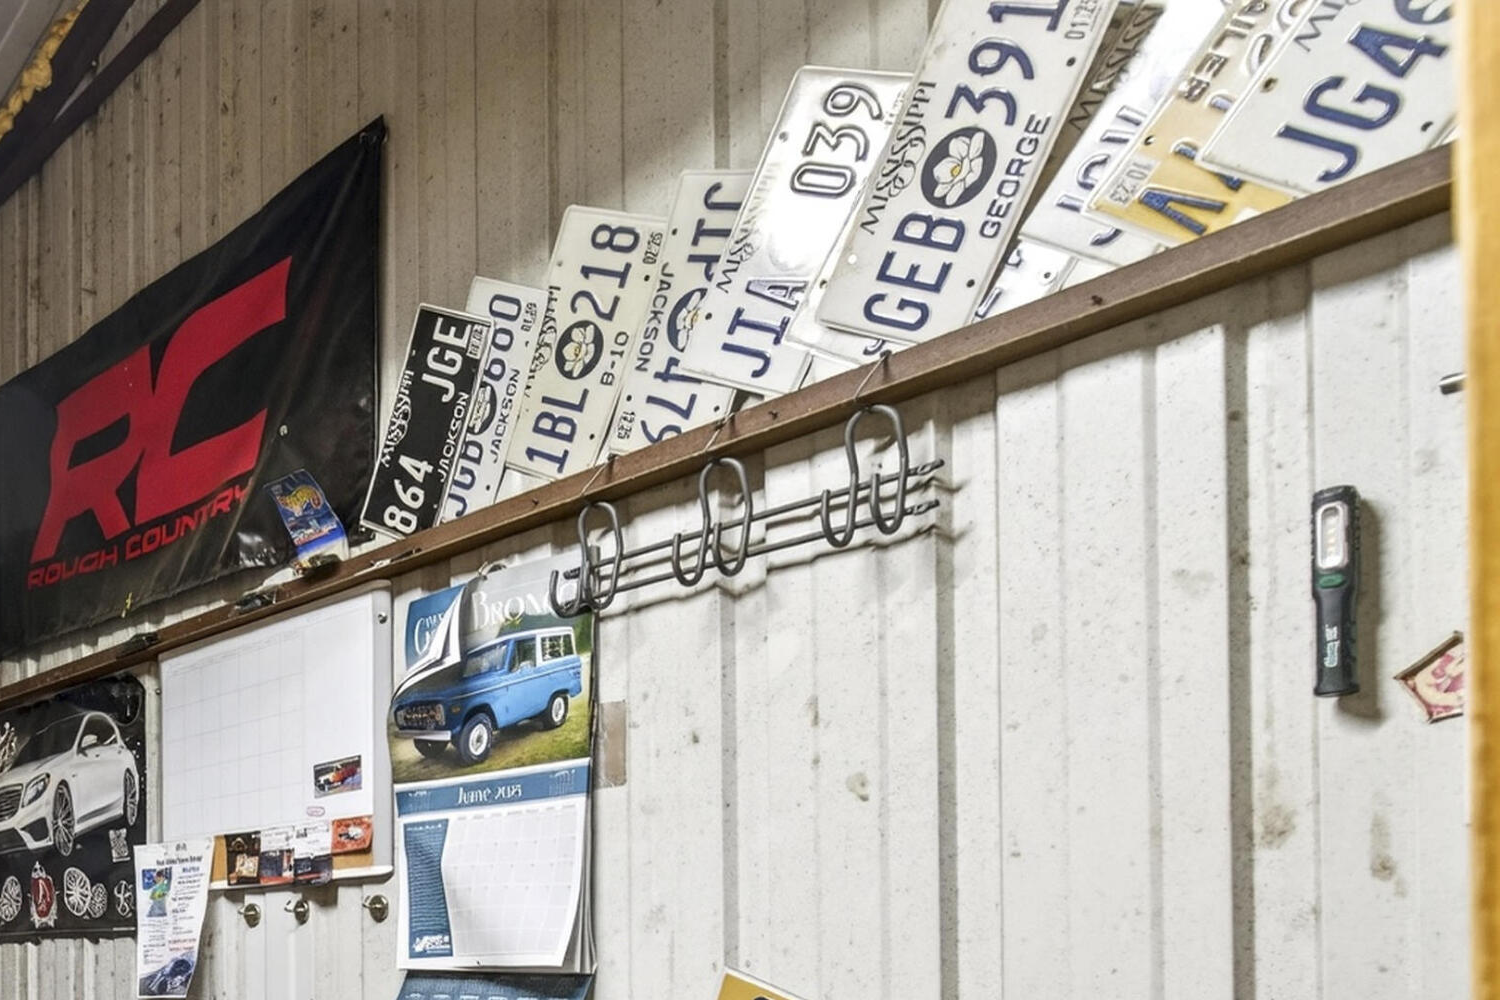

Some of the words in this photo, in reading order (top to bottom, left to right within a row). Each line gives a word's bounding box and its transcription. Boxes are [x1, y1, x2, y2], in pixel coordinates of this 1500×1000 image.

[790, 81, 882, 199] 039
[859, 81, 936, 235] MISSISSIPPI
[1276, 25, 1448, 182] JG4
[863, 213, 966, 332] GEB
[944, 0, 1066, 126] 391
[980, 114, 1052, 239] GEORGE
[525, 388, 589, 474] 1BL
[570, 224, 640, 321] 218
[600, 331, 629, 386] B-10
[635, 262, 675, 372] JACKSON
[721, 278, 808, 379] JIA
[30, 255, 293, 564] RC
[383, 454, 434, 534] 864
[421, 317, 472, 402] JGE
[437, 391, 470, 482] JACKSON
[490, 368, 520, 463] JACKSON
[27, 545, 118, 591] ROUGH
[125, 482, 251, 560] COUNTRY
[458, 786, 492, 804] June
